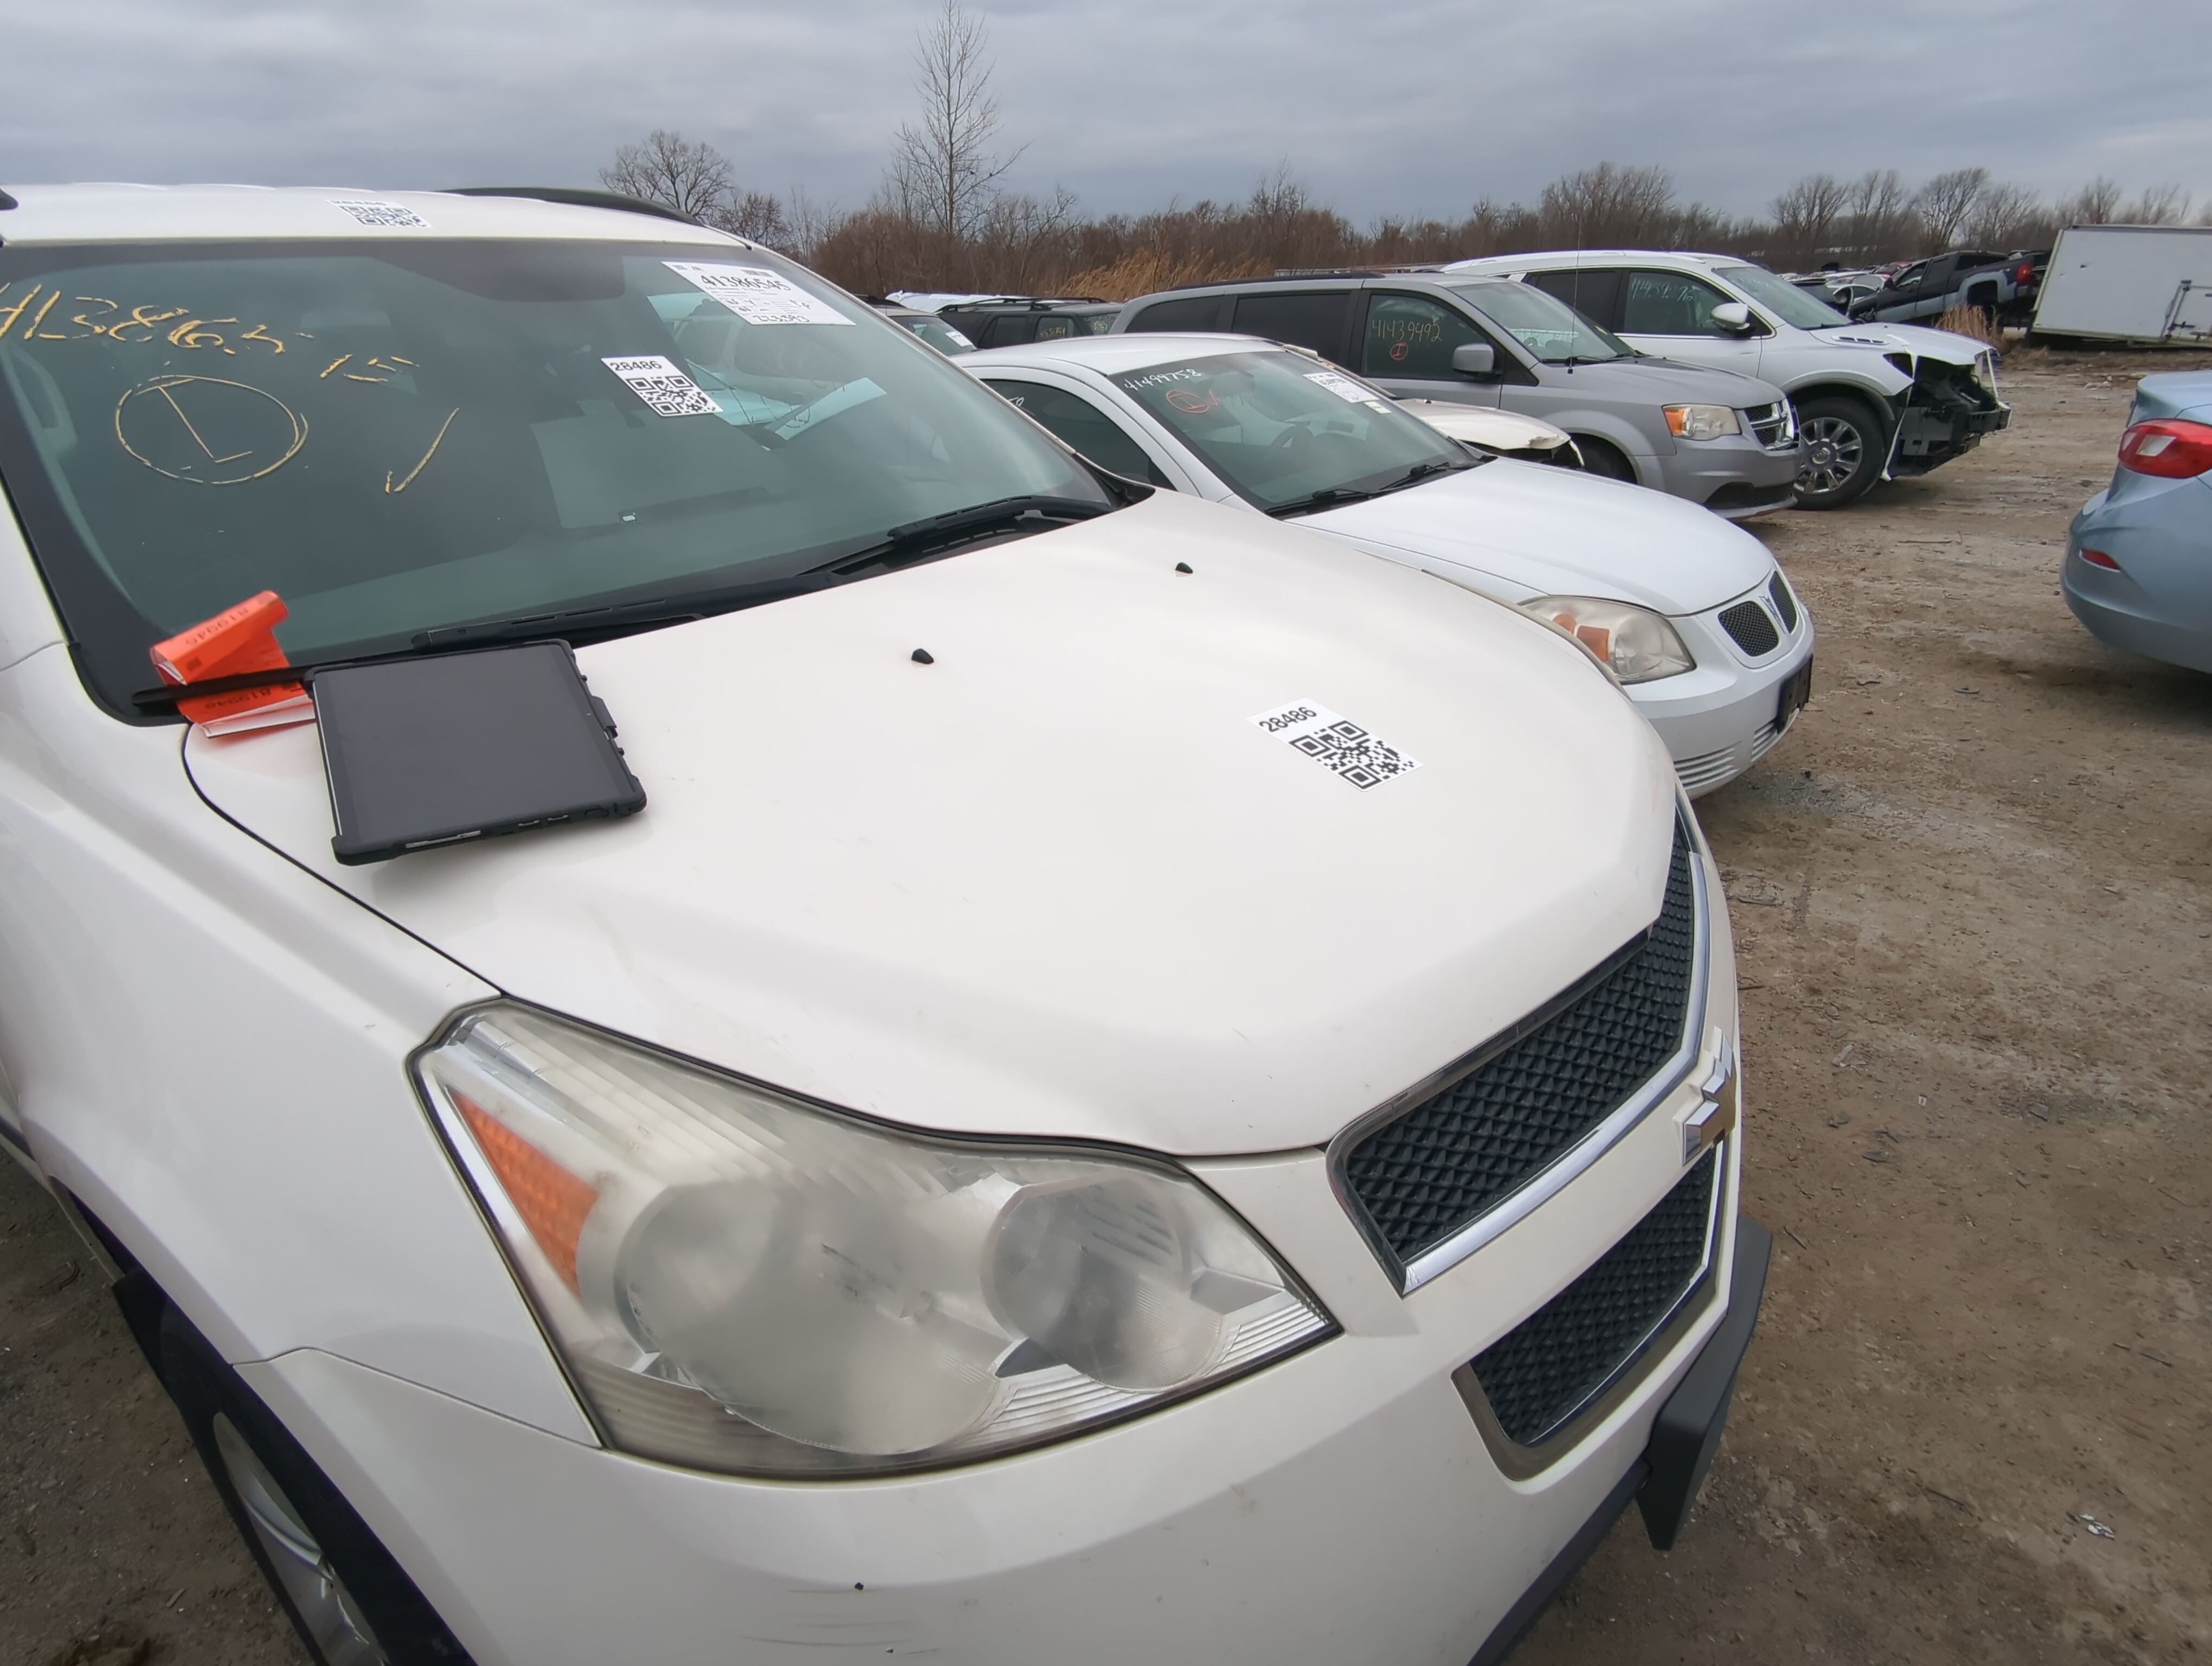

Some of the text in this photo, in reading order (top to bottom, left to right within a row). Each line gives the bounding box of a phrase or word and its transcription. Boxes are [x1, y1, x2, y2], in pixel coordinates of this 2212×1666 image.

[700, 275, 791, 291] 41386545
[609, 361, 662, 371] 28486
[1124, 369, 1201, 391] 41499758
[1259, 707, 1317, 733] 28486
